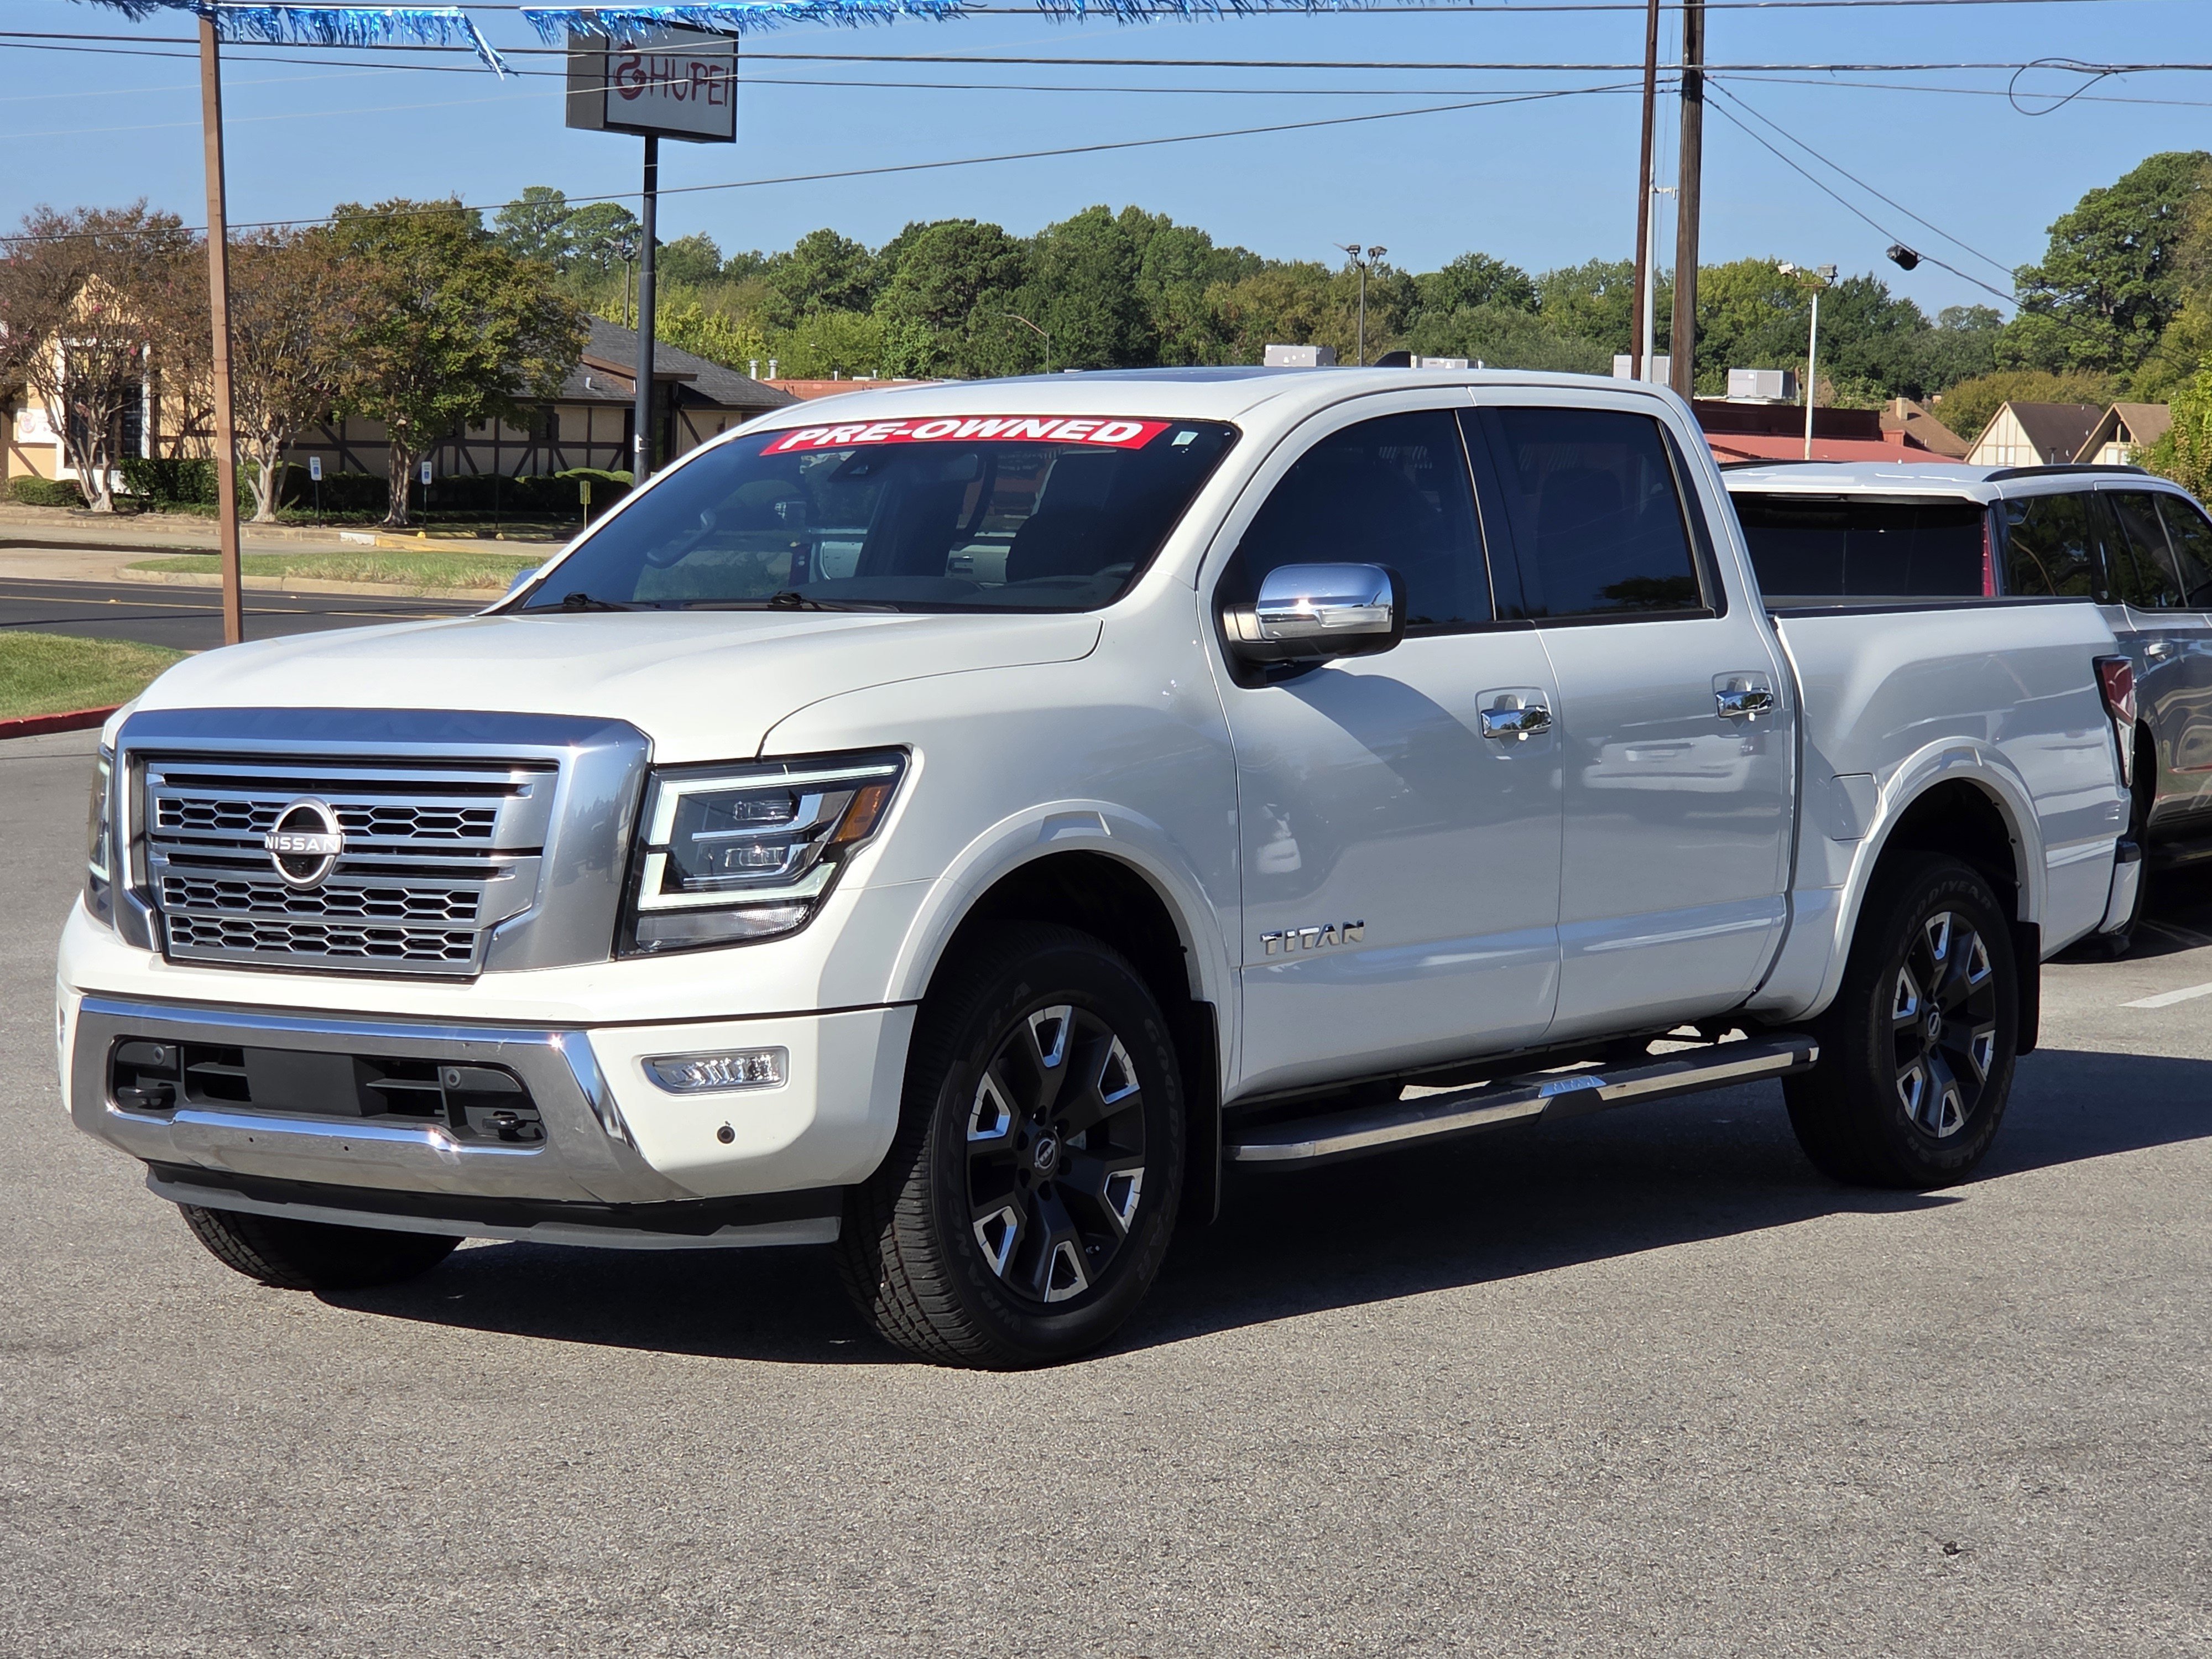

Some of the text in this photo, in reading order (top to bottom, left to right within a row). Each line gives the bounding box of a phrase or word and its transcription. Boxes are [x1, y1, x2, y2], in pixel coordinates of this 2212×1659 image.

[778, 419, 1143, 450] PRE-OWNED
[265, 835, 339, 852] NISSAN
[1260, 919, 1364, 955] TITAN
